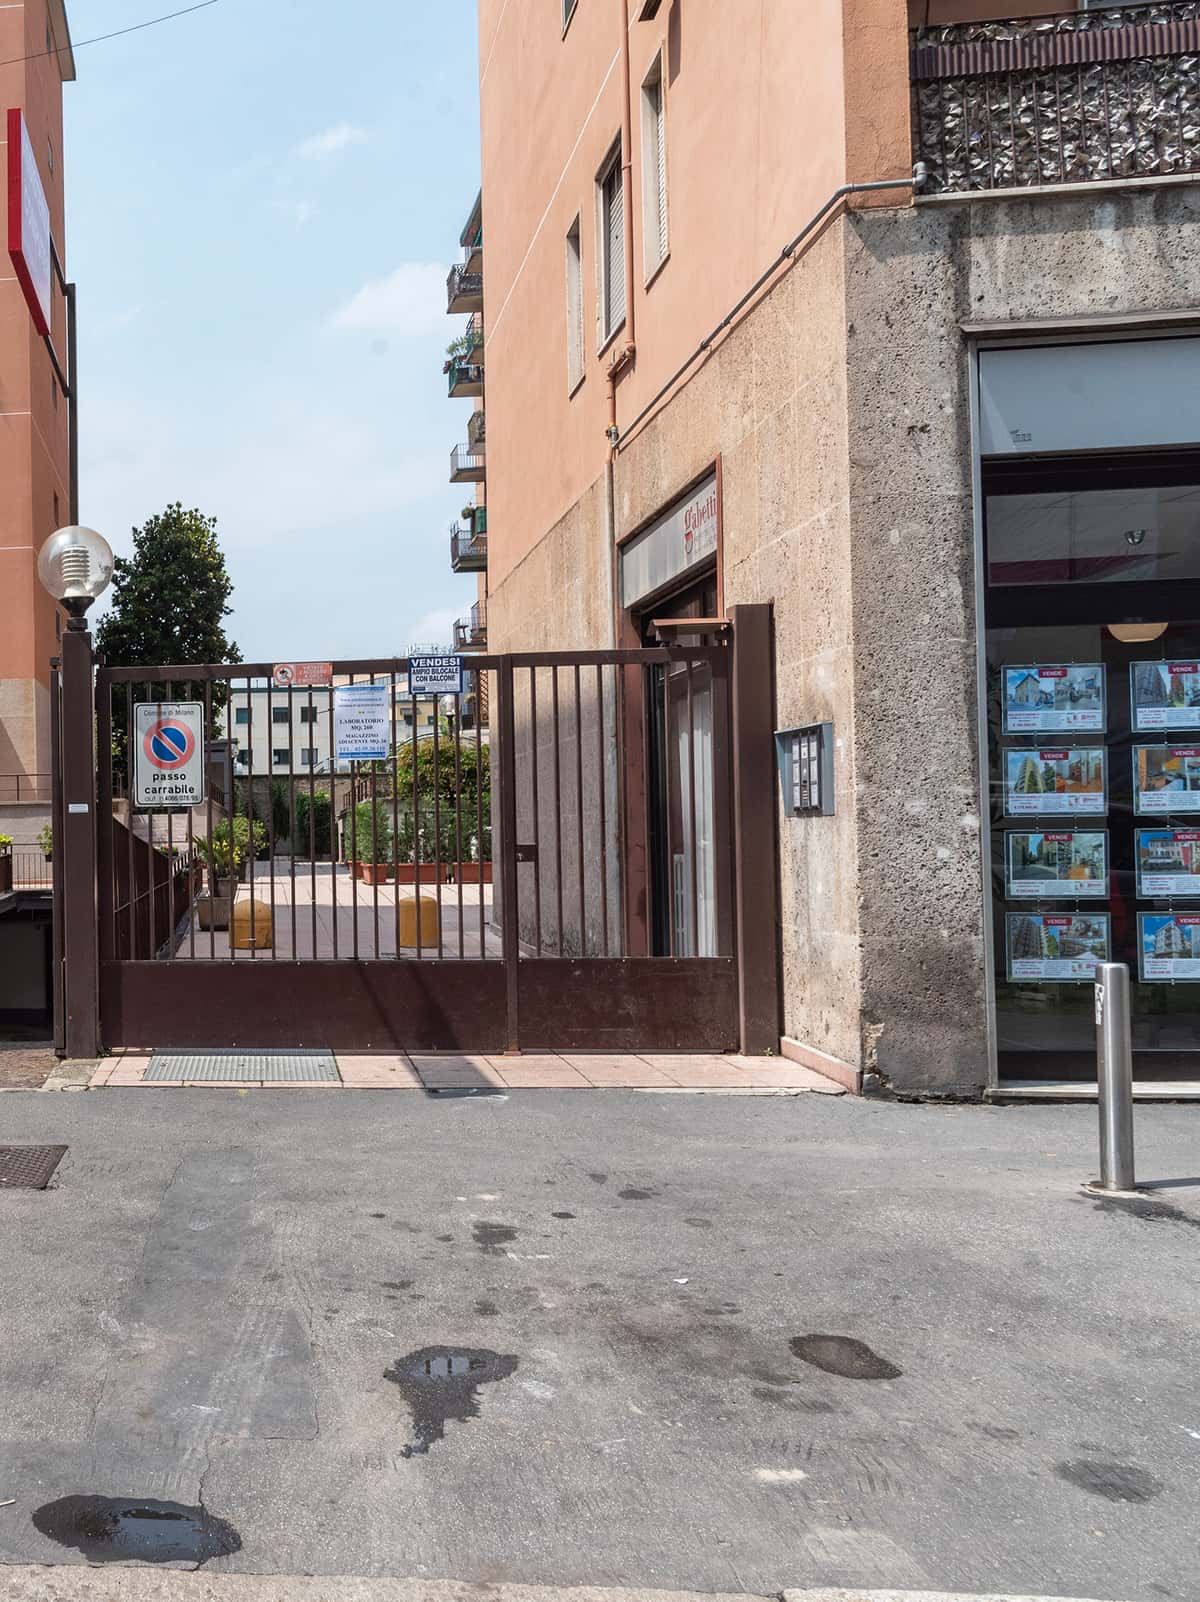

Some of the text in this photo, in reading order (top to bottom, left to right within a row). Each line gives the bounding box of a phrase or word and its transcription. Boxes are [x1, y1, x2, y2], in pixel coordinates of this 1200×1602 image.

[411, 657, 460, 667] VENDESI
[431, 666, 459, 674] BILOCALE
[429, 674, 456, 682] BALCONE
[152, 773, 186, 783] passo
[144, 784, 195, 794] carrabile
